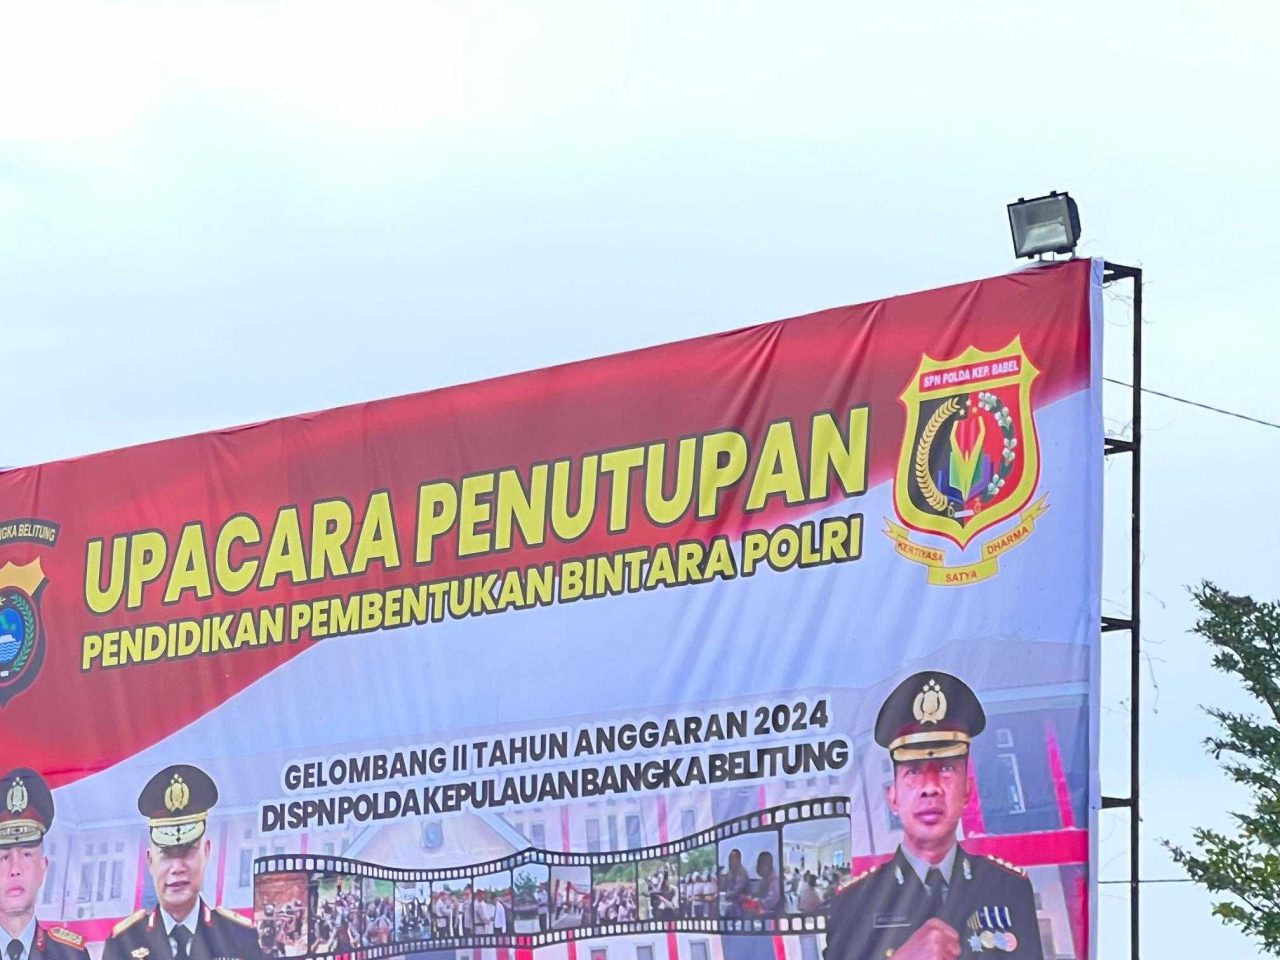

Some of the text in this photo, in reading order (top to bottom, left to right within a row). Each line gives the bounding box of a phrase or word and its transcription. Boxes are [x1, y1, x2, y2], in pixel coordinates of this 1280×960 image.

[923, 359, 1019, 388] SPN POLDA KEP. BABEL
[18, 523, 56, 542] BELITUNG
[83, 405, 871, 615] UPACARA PENUTUPAN
[945, 571, 978, 584] SATYA
[986, 525, 1029, 555] DHARMA
[80, 515, 864, 672] PENDIDIKAN PEMBENTUKAN BINTARA POLRI
[284, 700, 829, 791] GELOMBANG II TAHUN ANGGARAN 2024
